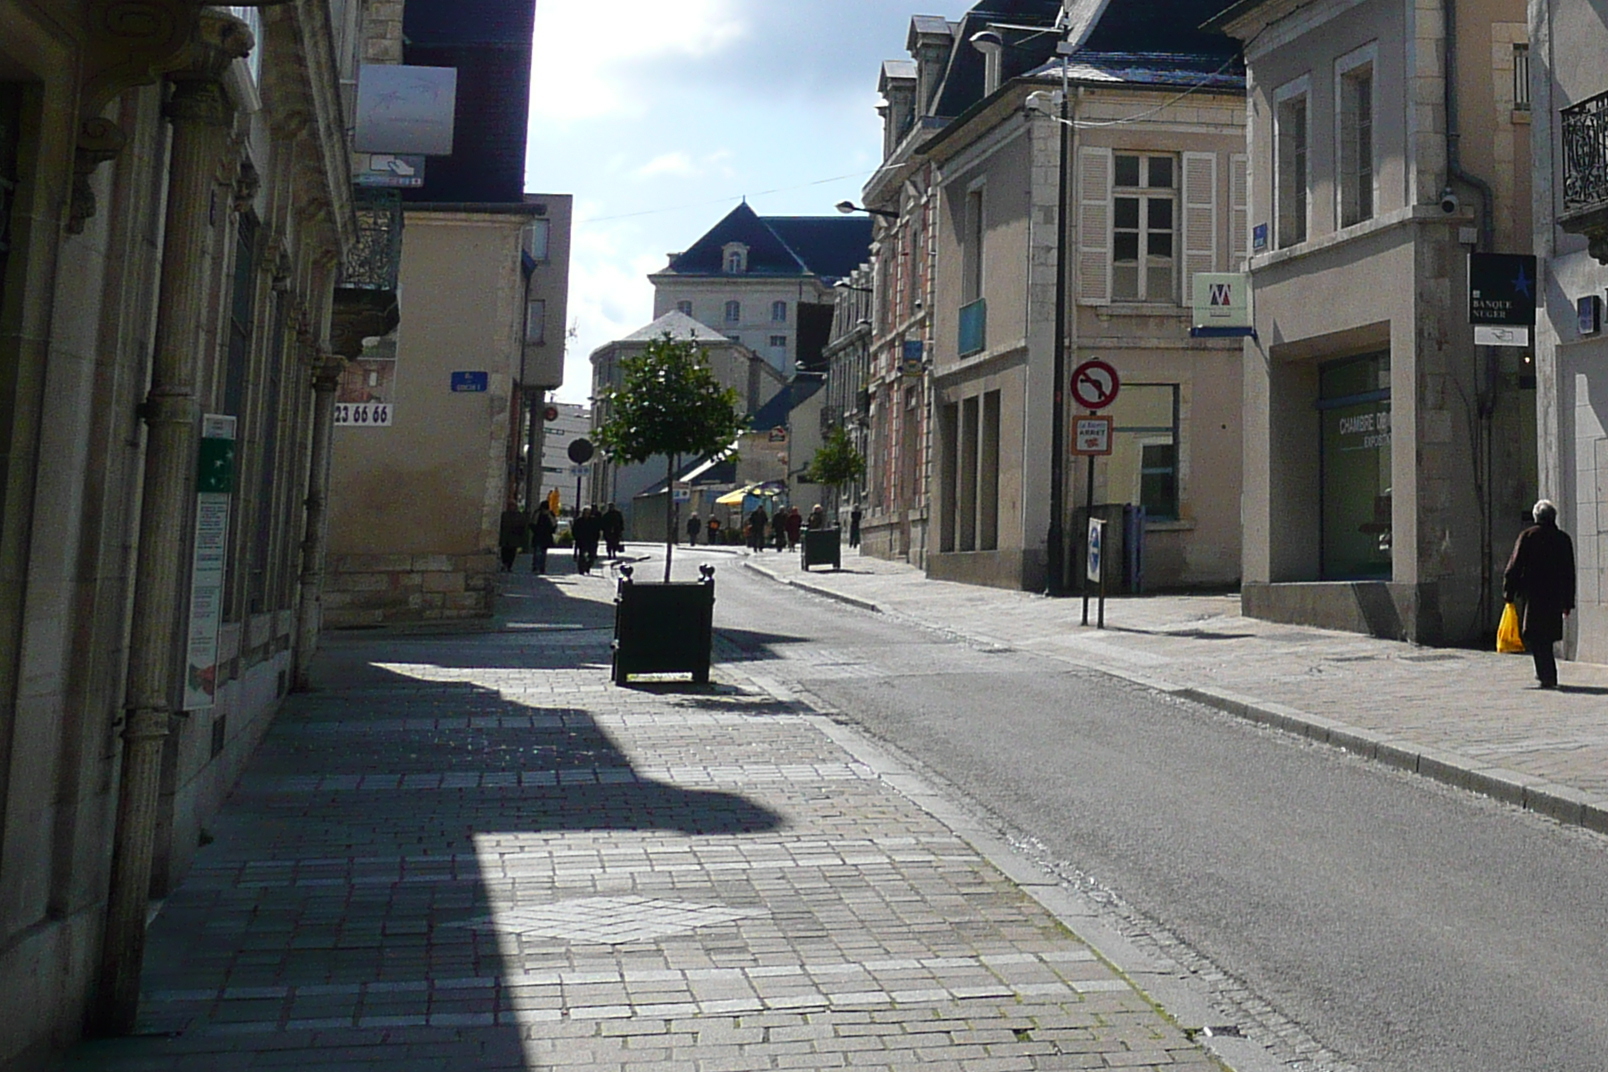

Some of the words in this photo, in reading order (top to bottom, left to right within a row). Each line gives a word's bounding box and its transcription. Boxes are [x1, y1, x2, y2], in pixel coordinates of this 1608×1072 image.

[1472, 299, 1513, 309] BANQUE
[1472, 309, 1507, 319] NUGER
[353, 405, 368, 423] 66
[372, 405, 388, 423] 66
[1339, 414, 1374, 435] CHAMBRE
